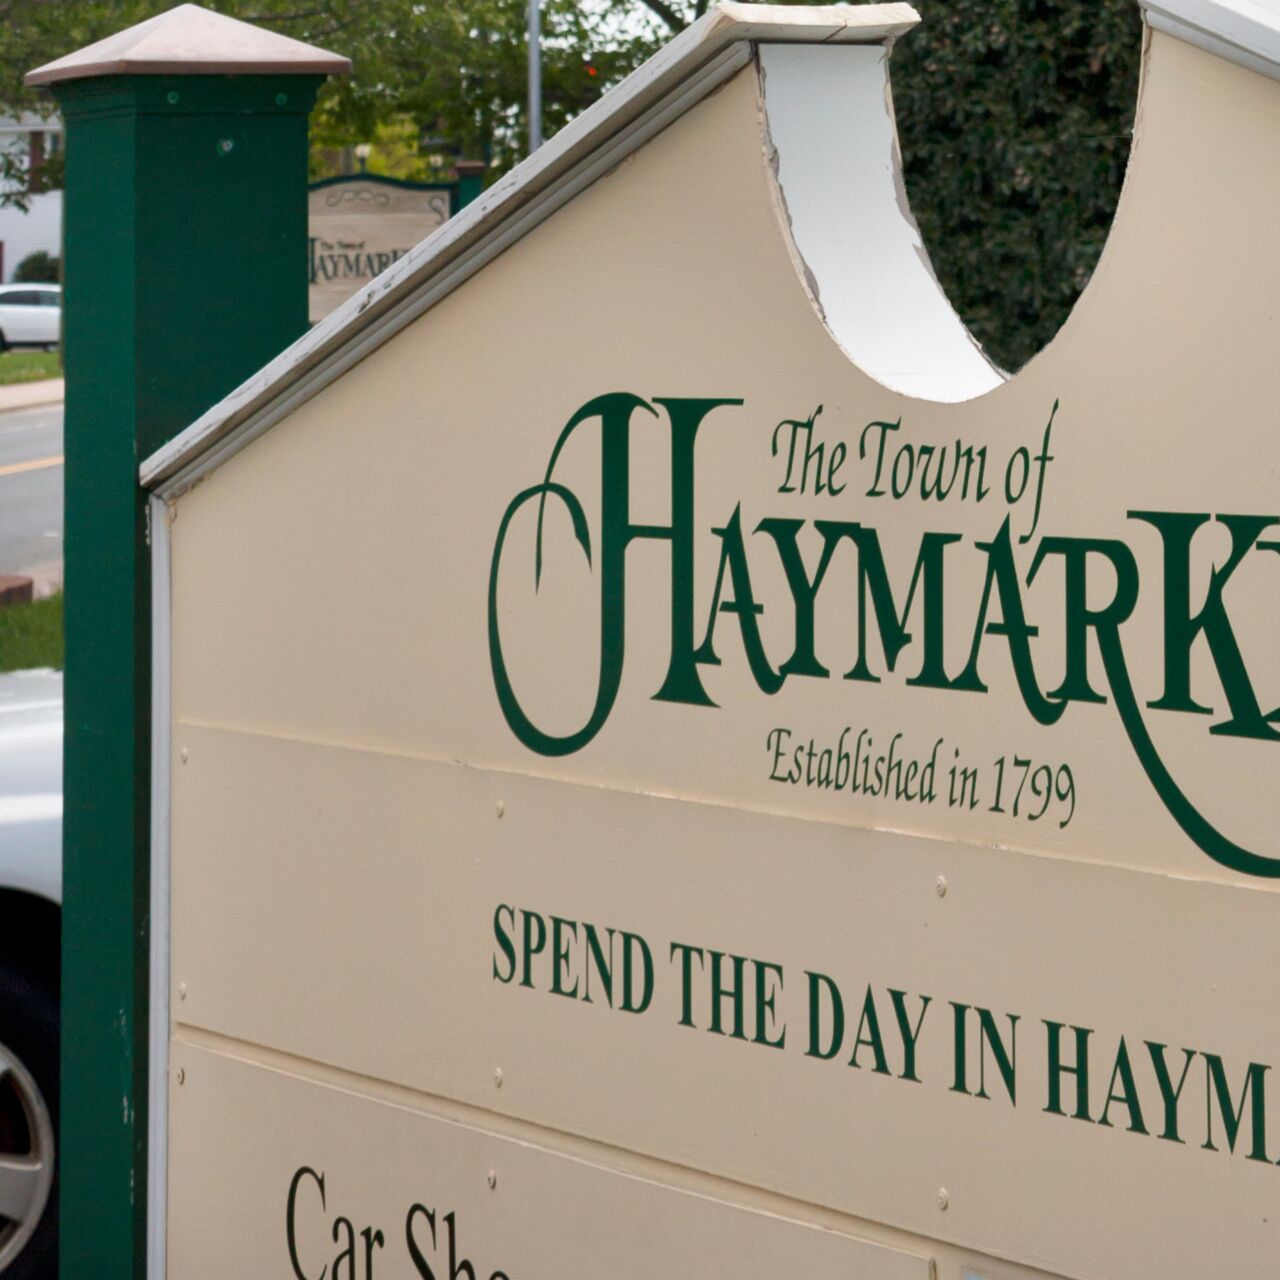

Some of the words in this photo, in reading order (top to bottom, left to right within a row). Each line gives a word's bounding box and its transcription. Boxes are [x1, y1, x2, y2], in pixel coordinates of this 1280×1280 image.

[772, 404, 847, 497] The
[859, 416, 990, 503] Town
[1005, 397, 1059, 544] of
[766, 726, 943, 804] Established
[949, 747, 979, 811] in
[988, 752, 1076, 830] 1799
[492, 903, 655, 1014] SPEND
[670, 941, 787, 1050] THE
[803, 970, 932, 1083] DAY
[948, 1001, 1021, 1108] IN
[286, 1165, 385, 1280] Car
[405, 1202, 511, 1280] Sh
